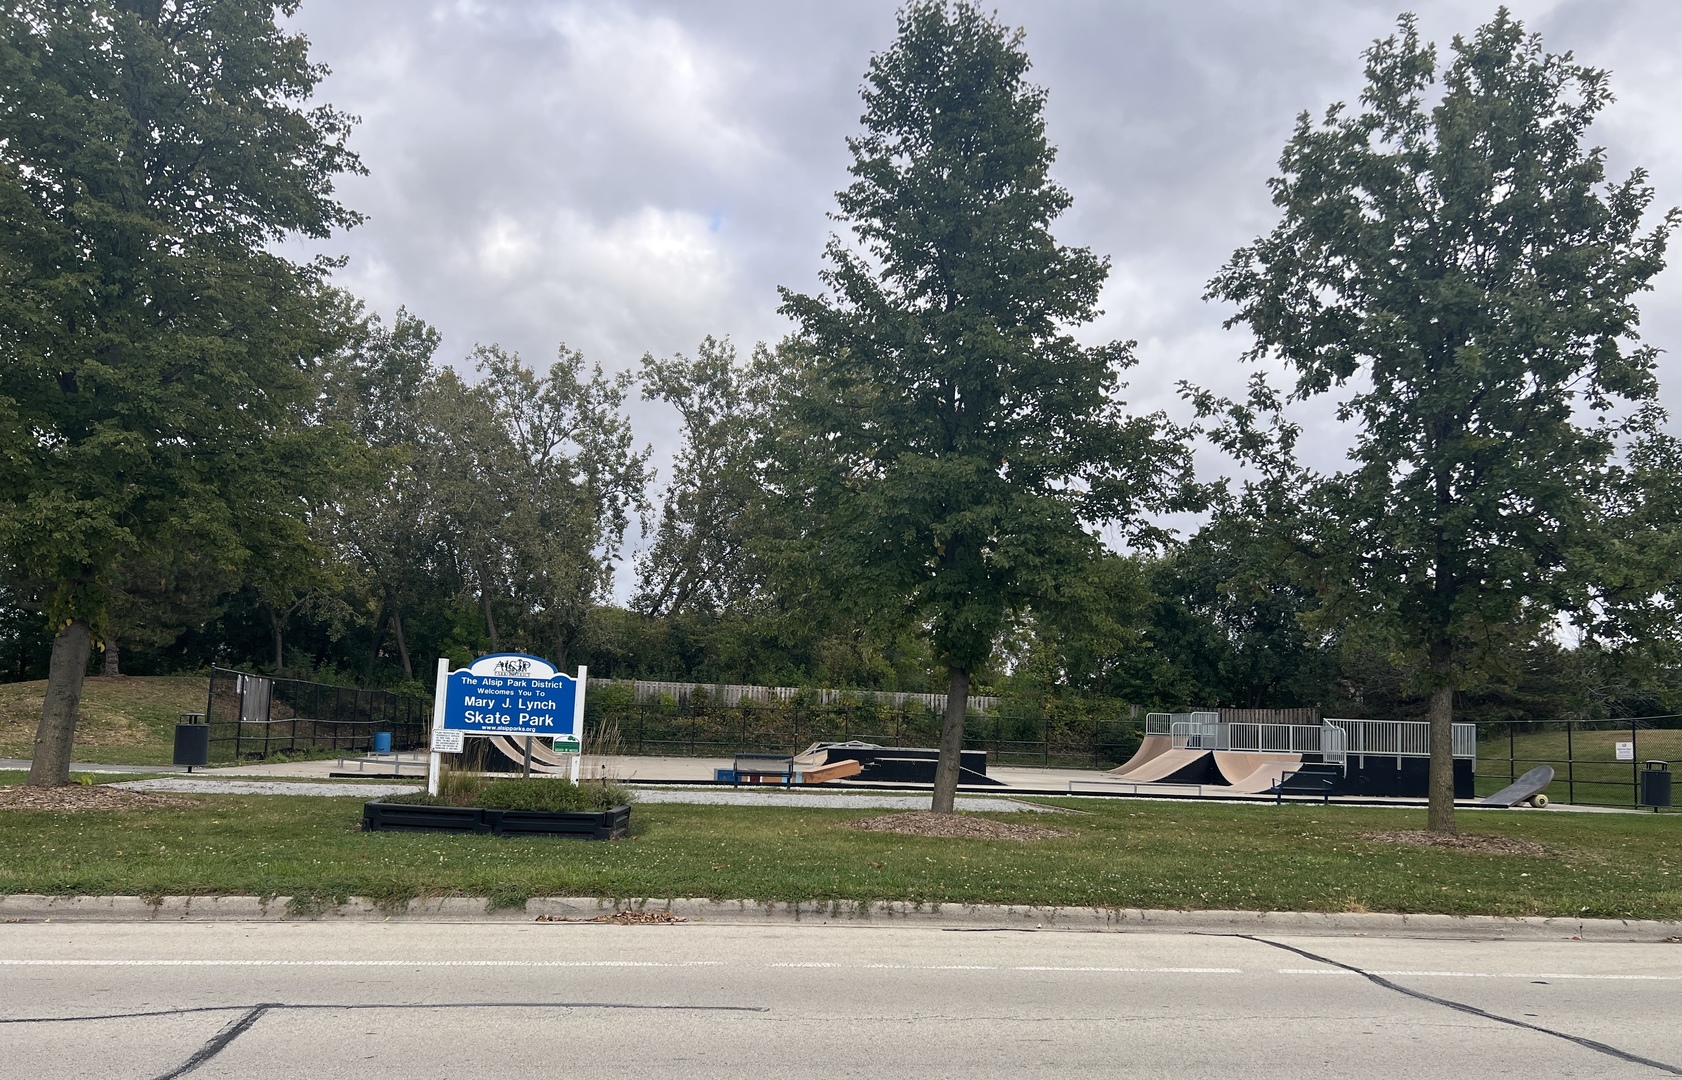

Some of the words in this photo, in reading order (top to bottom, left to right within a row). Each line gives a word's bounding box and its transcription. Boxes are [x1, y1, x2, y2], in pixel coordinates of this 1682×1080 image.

[461, 677, 478, 685] The
[482, 678, 503, 687] Alsip
[507, 679, 527, 687] Park
[531, 680, 563, 689] District
[477, 688, 514, 696] Welcomes
[464, 696, 495, 709] Mary
[502, 698, 512, 708] J.
[518, 699, 556, 711] Lynch
[464, 711, 510, 724] Skate
[519, 713, 554, 726] Park
[482, 725, 536, 733] www.alsipparks.org
